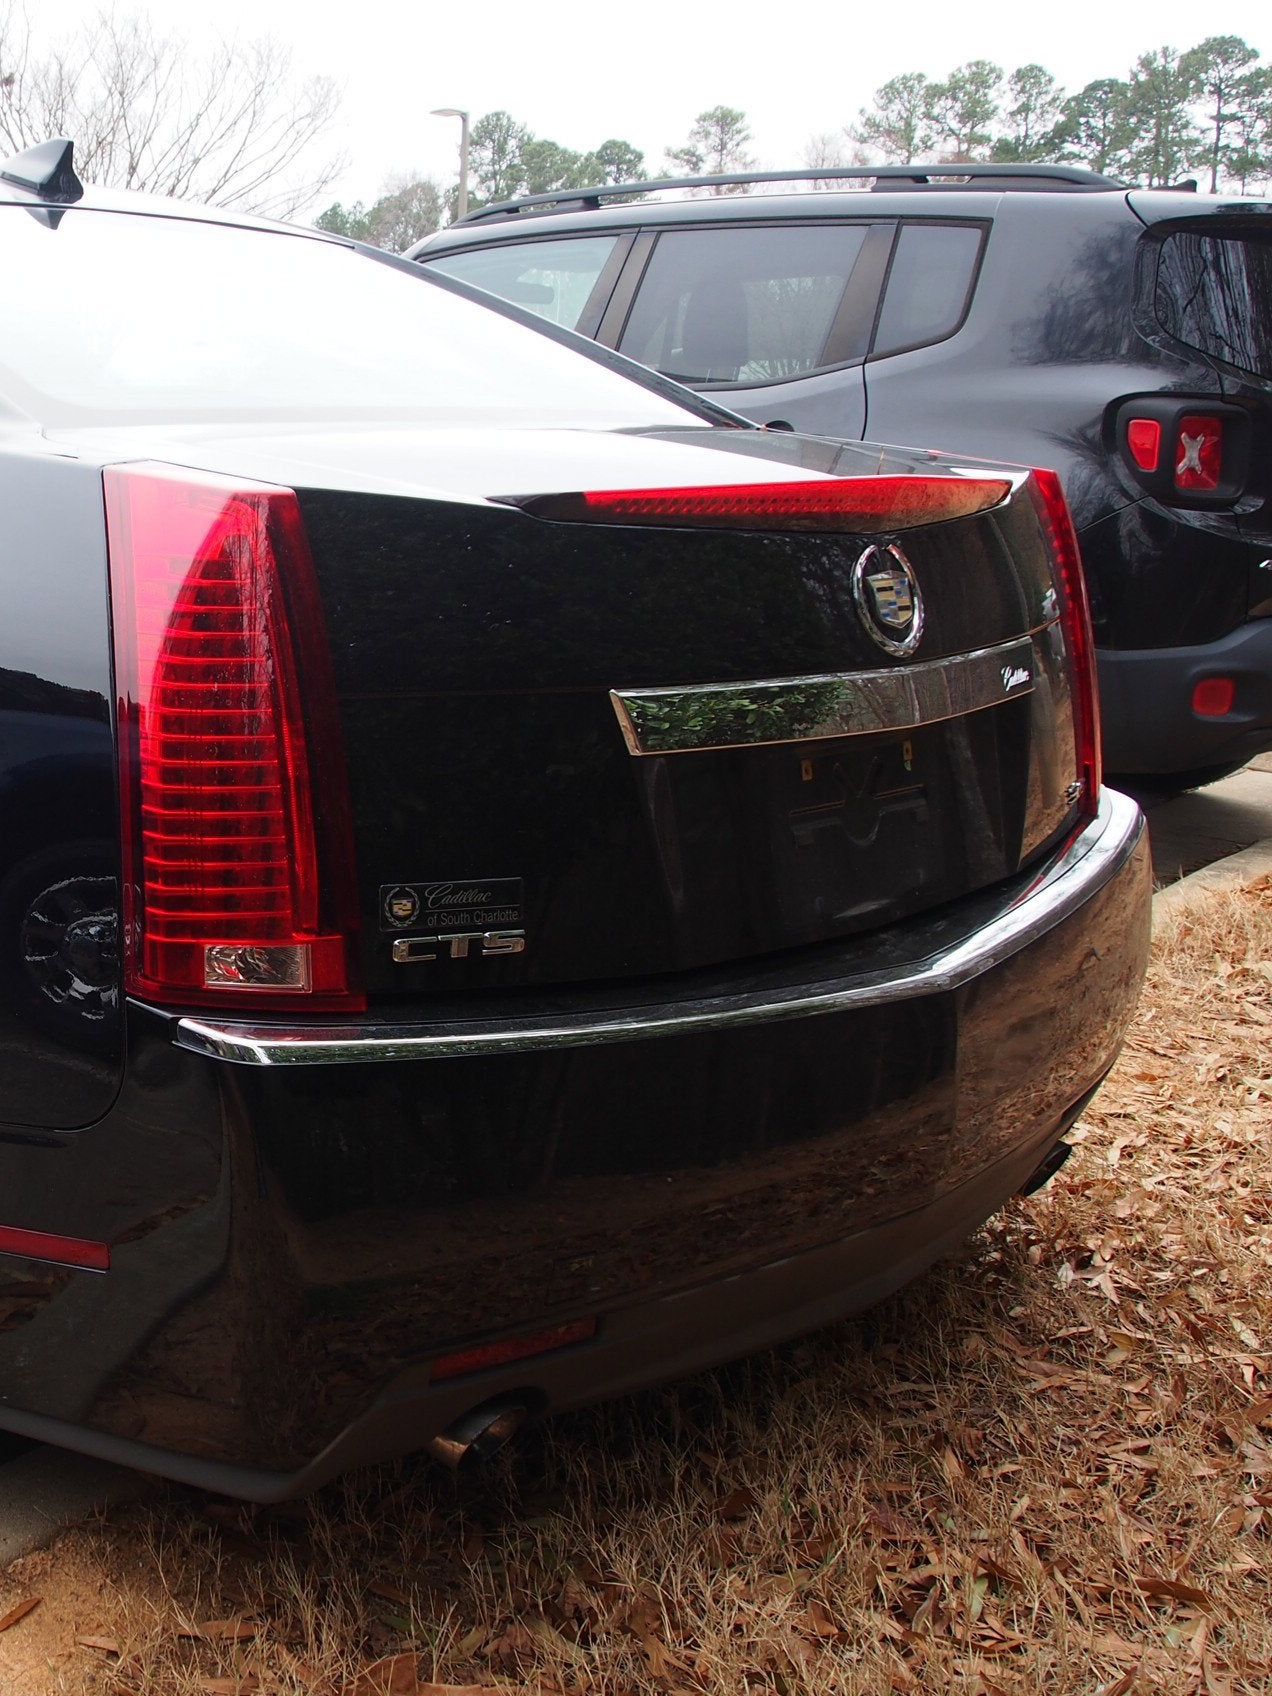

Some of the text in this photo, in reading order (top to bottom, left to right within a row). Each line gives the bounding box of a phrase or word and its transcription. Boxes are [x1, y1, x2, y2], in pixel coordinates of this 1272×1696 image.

[424, 883, 492, 909] Cadillac
[427, 909, 519, 926] of South Charlotte
[392, 929, 526, 963] CTS
